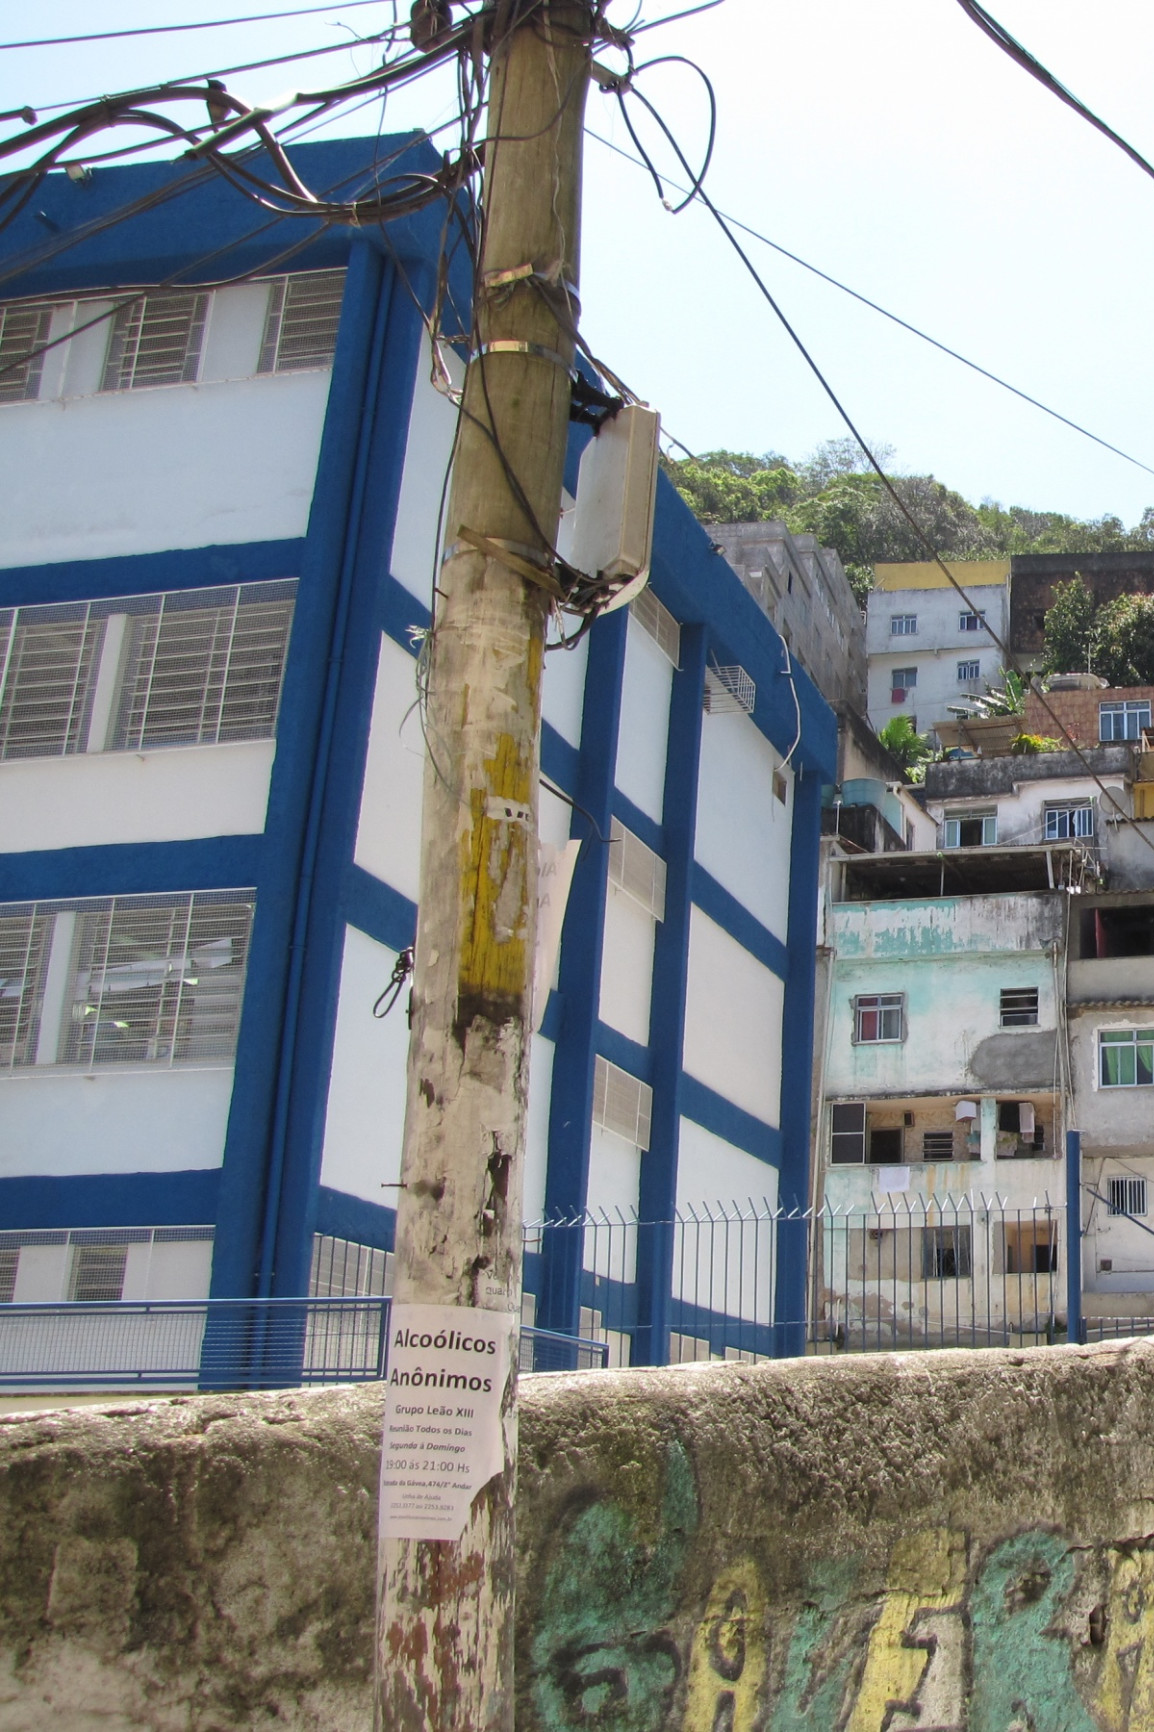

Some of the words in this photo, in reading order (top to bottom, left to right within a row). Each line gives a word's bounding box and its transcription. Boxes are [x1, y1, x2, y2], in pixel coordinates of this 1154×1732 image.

[394, 1328, 496, 1355] Alcoólicos
[390, 1366, 492, 1393] Anônimos
[395, 1404, 424, 1416] Grupo
[427, 1405, 453, 1416] Leão
[456, 1407, 474, 1418] XIII
[416, 1425, 441, 1434] Todos
[455, 1427, 472, 1437] Dias
[426, 1442, 466, 1453] Domingo
[422, 1460, 454, 1472] 21:00
[457, 1463, 470, 1473] Hs
